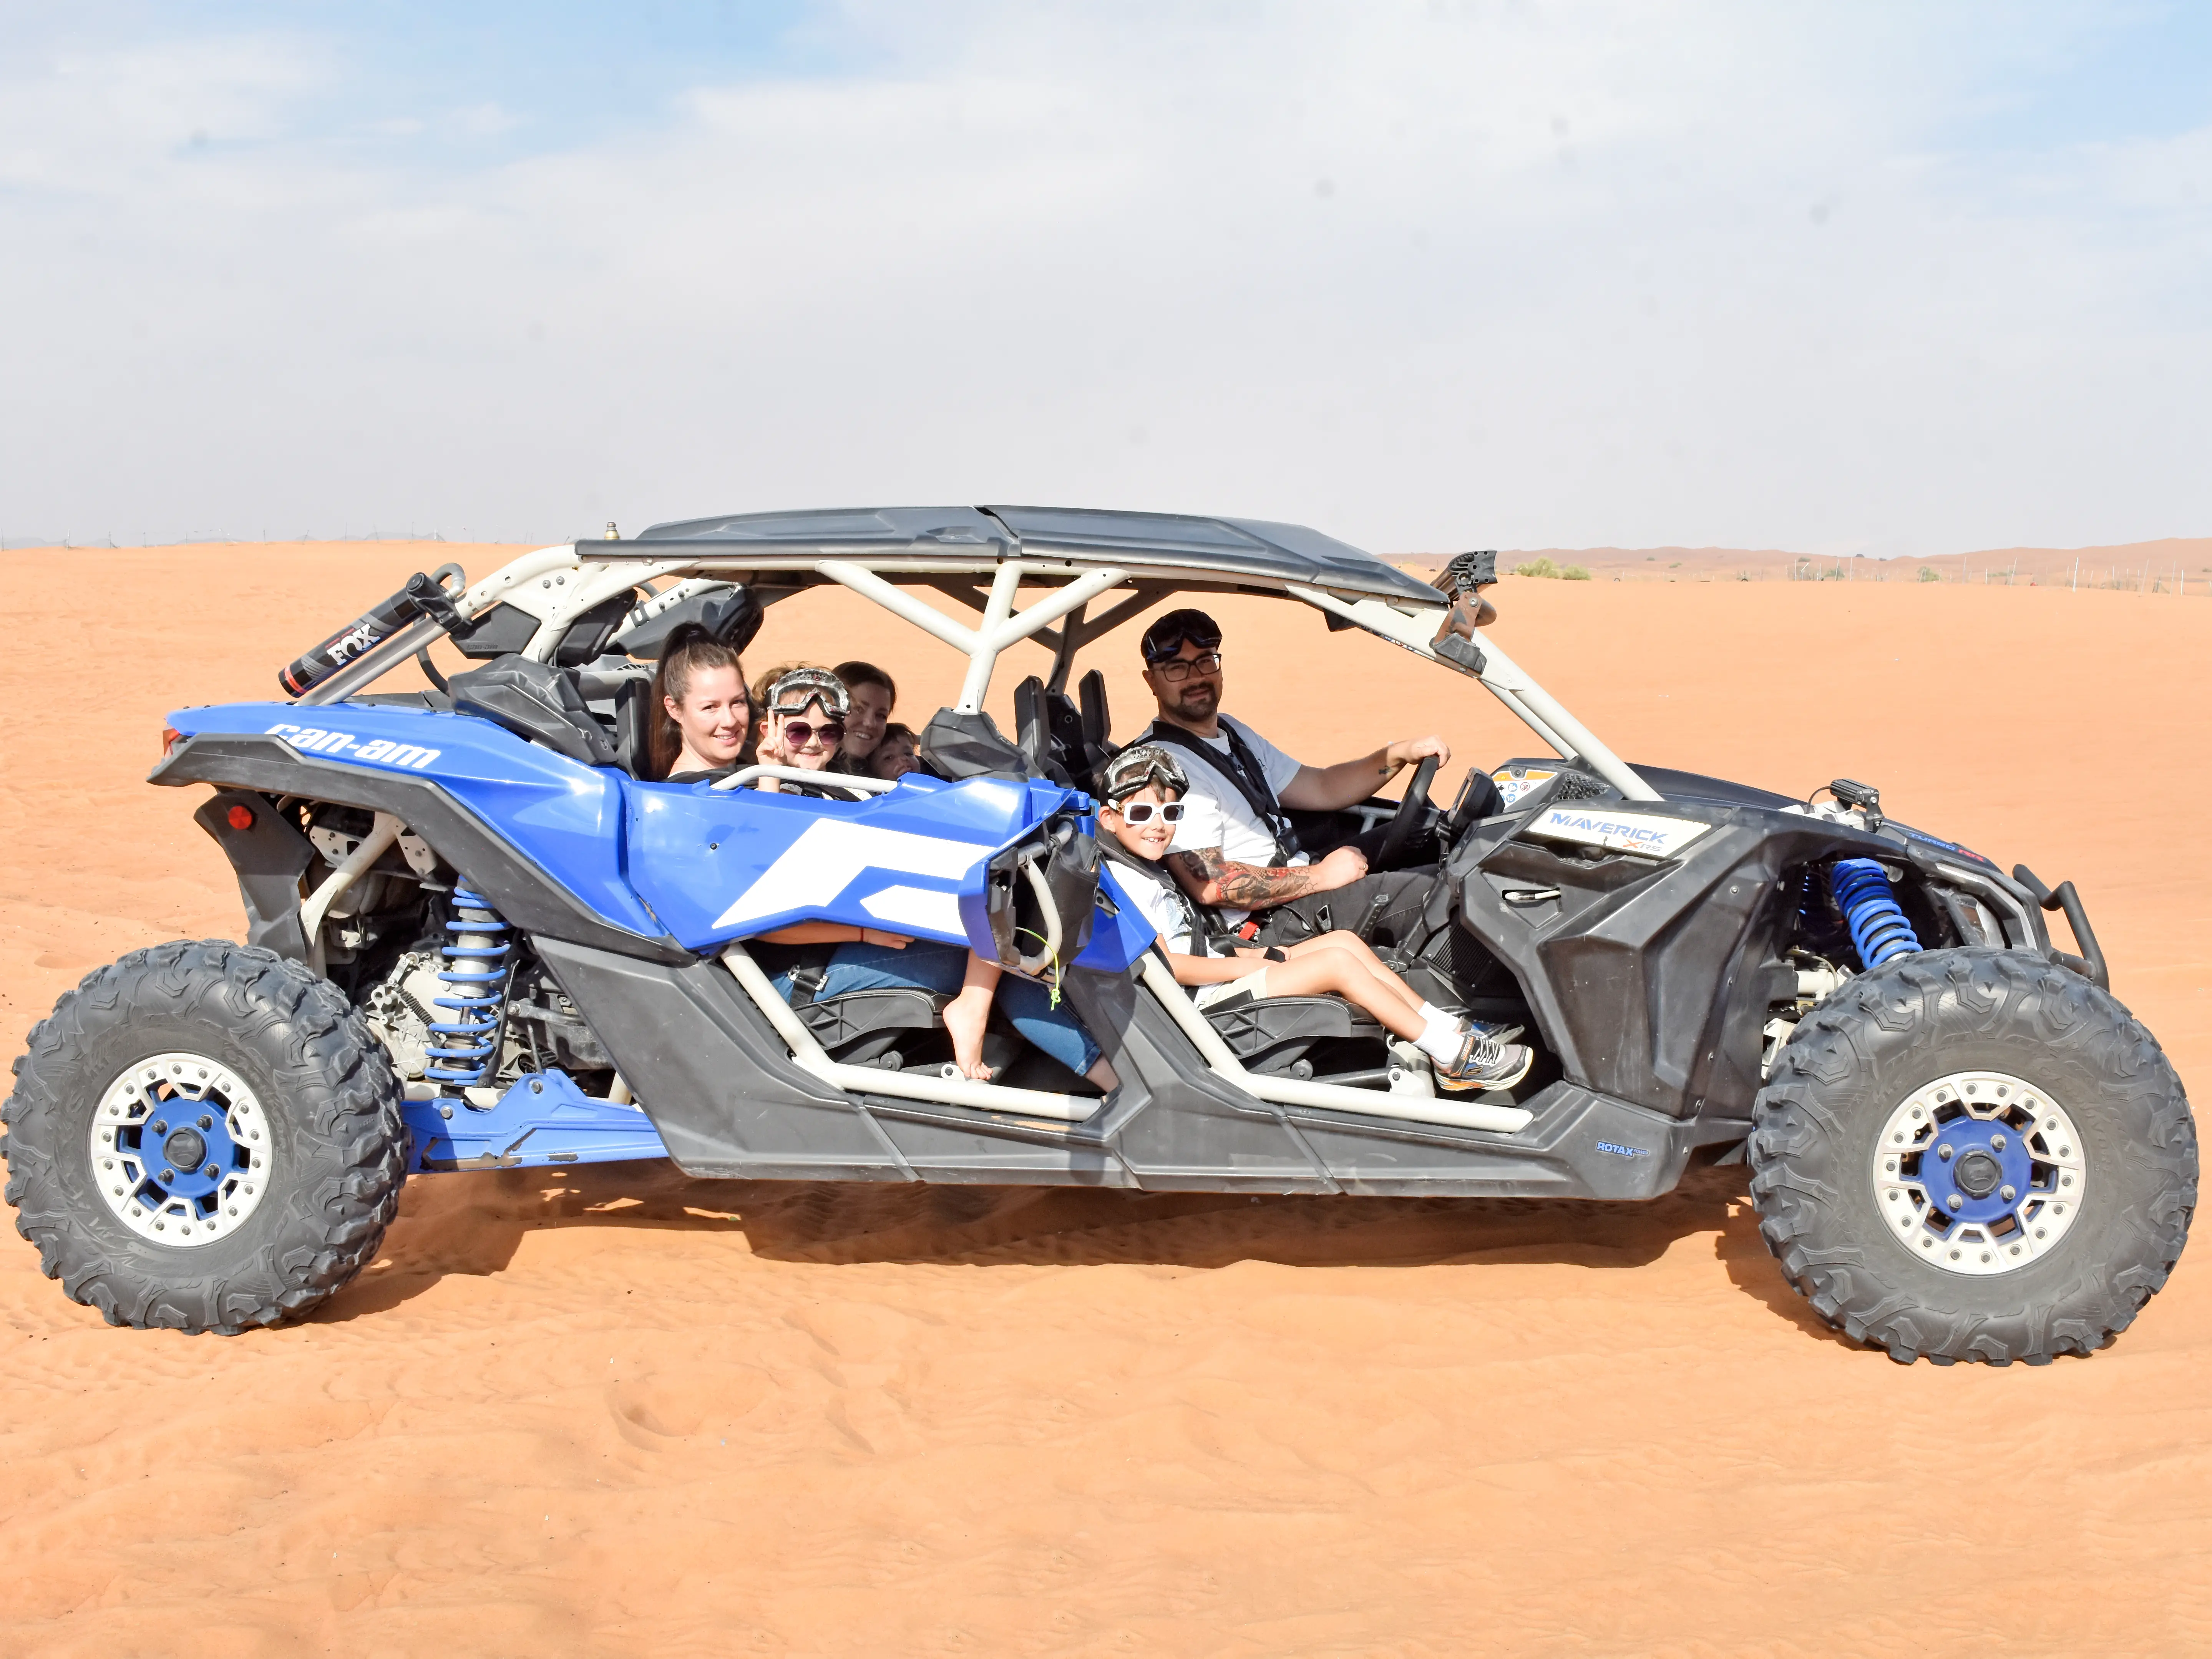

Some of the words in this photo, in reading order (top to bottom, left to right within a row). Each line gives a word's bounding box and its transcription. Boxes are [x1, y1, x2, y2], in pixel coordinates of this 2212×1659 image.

[327, 624, 381, 665] FOX
[264, 724, 441, 768] can-am
[1550, 813, 1668, 844] MAVERICK
[1909, 833, 1955, 850] TURBO
[1597, 1142, 1633, 1156] ROTAX
